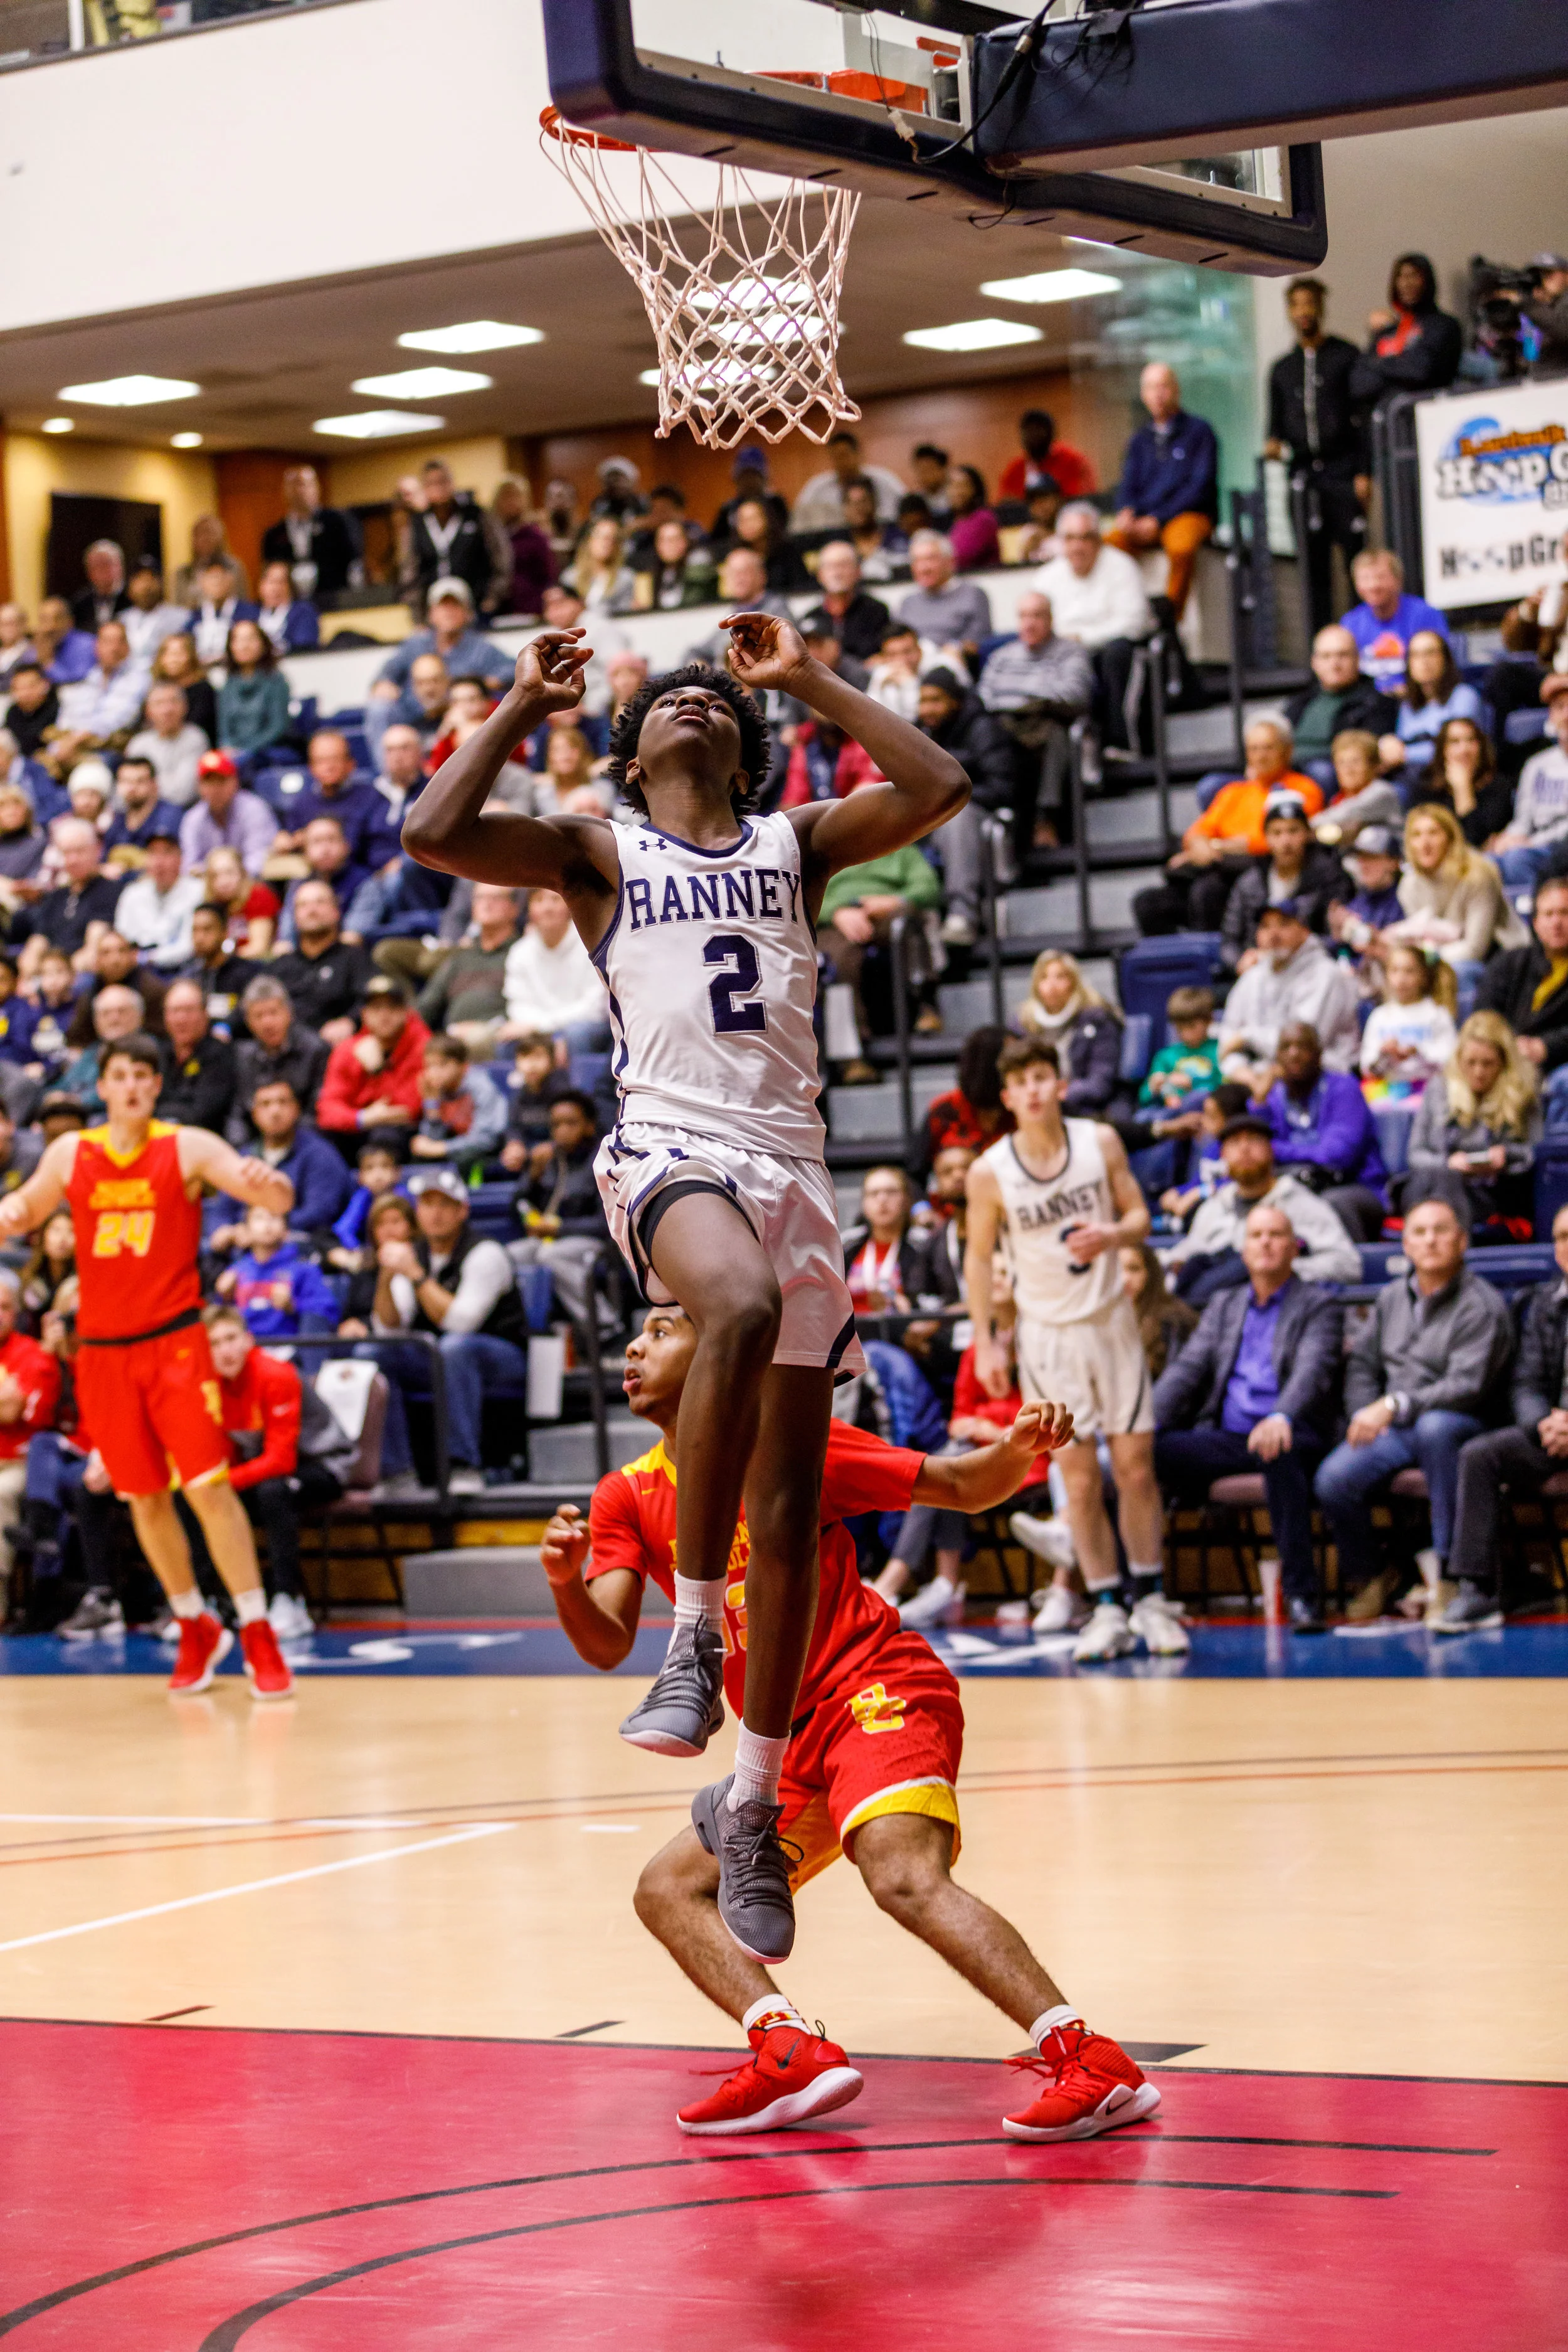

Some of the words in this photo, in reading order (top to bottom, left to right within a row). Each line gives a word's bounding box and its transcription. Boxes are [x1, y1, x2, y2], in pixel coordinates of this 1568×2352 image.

[625, 868, 800, 932] RANNEY
[702, 935, 768, 1036] 2
[1016, 1177, 1103, 1231] RANNEY
[92, 1210, 156, 1258] 24
